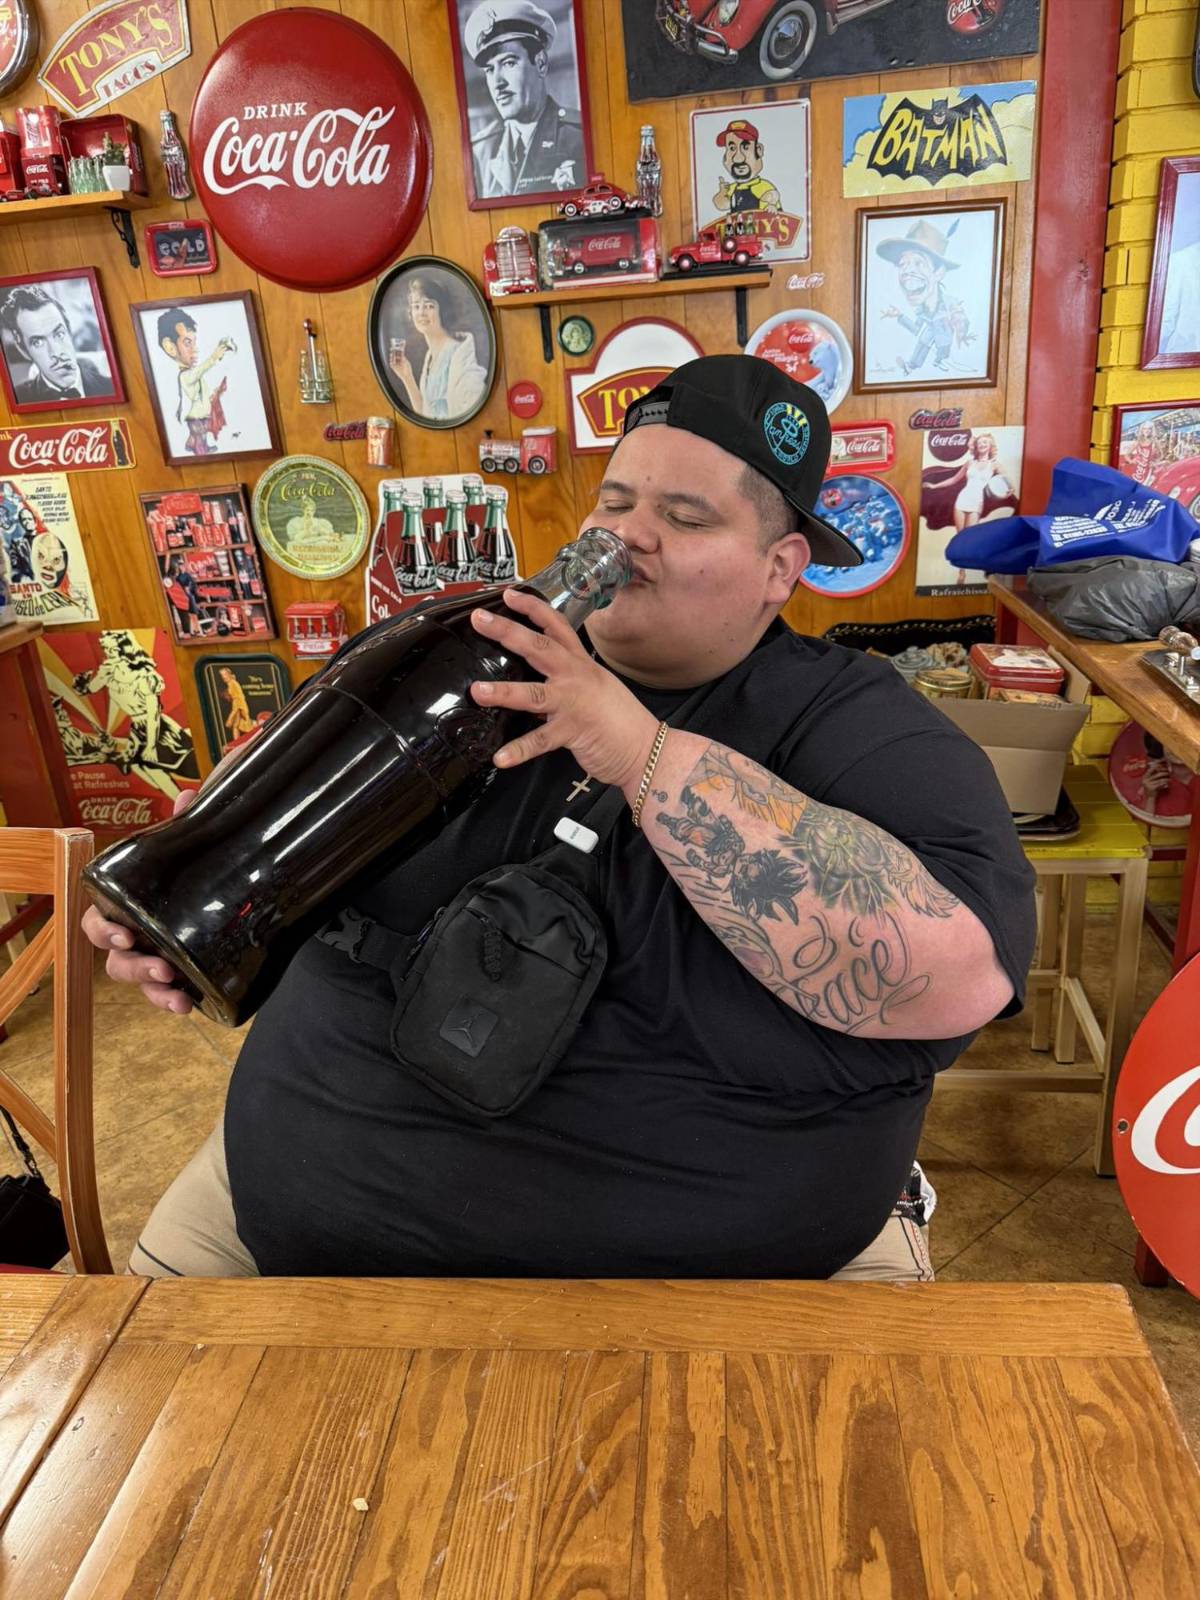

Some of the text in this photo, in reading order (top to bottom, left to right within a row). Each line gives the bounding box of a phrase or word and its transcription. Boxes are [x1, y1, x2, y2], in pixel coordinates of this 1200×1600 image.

[58, 3, 175, 97] TONY'S
[101, 60, 156, 98] TACOS
[243, 101, 308, 120] DRINK
[202, 105, 396, 196] Coca-Cola
[871, 103, 1005, 174] BATMAN
[8, 426, 108, 469] Coca-Cola
[931, 434, 968, 448] Coca-Cola
[9, 582, 43, 594] SANTO
[78, 771, 106, 780] Pause
[84, 780, 131, 789] Refreshes
